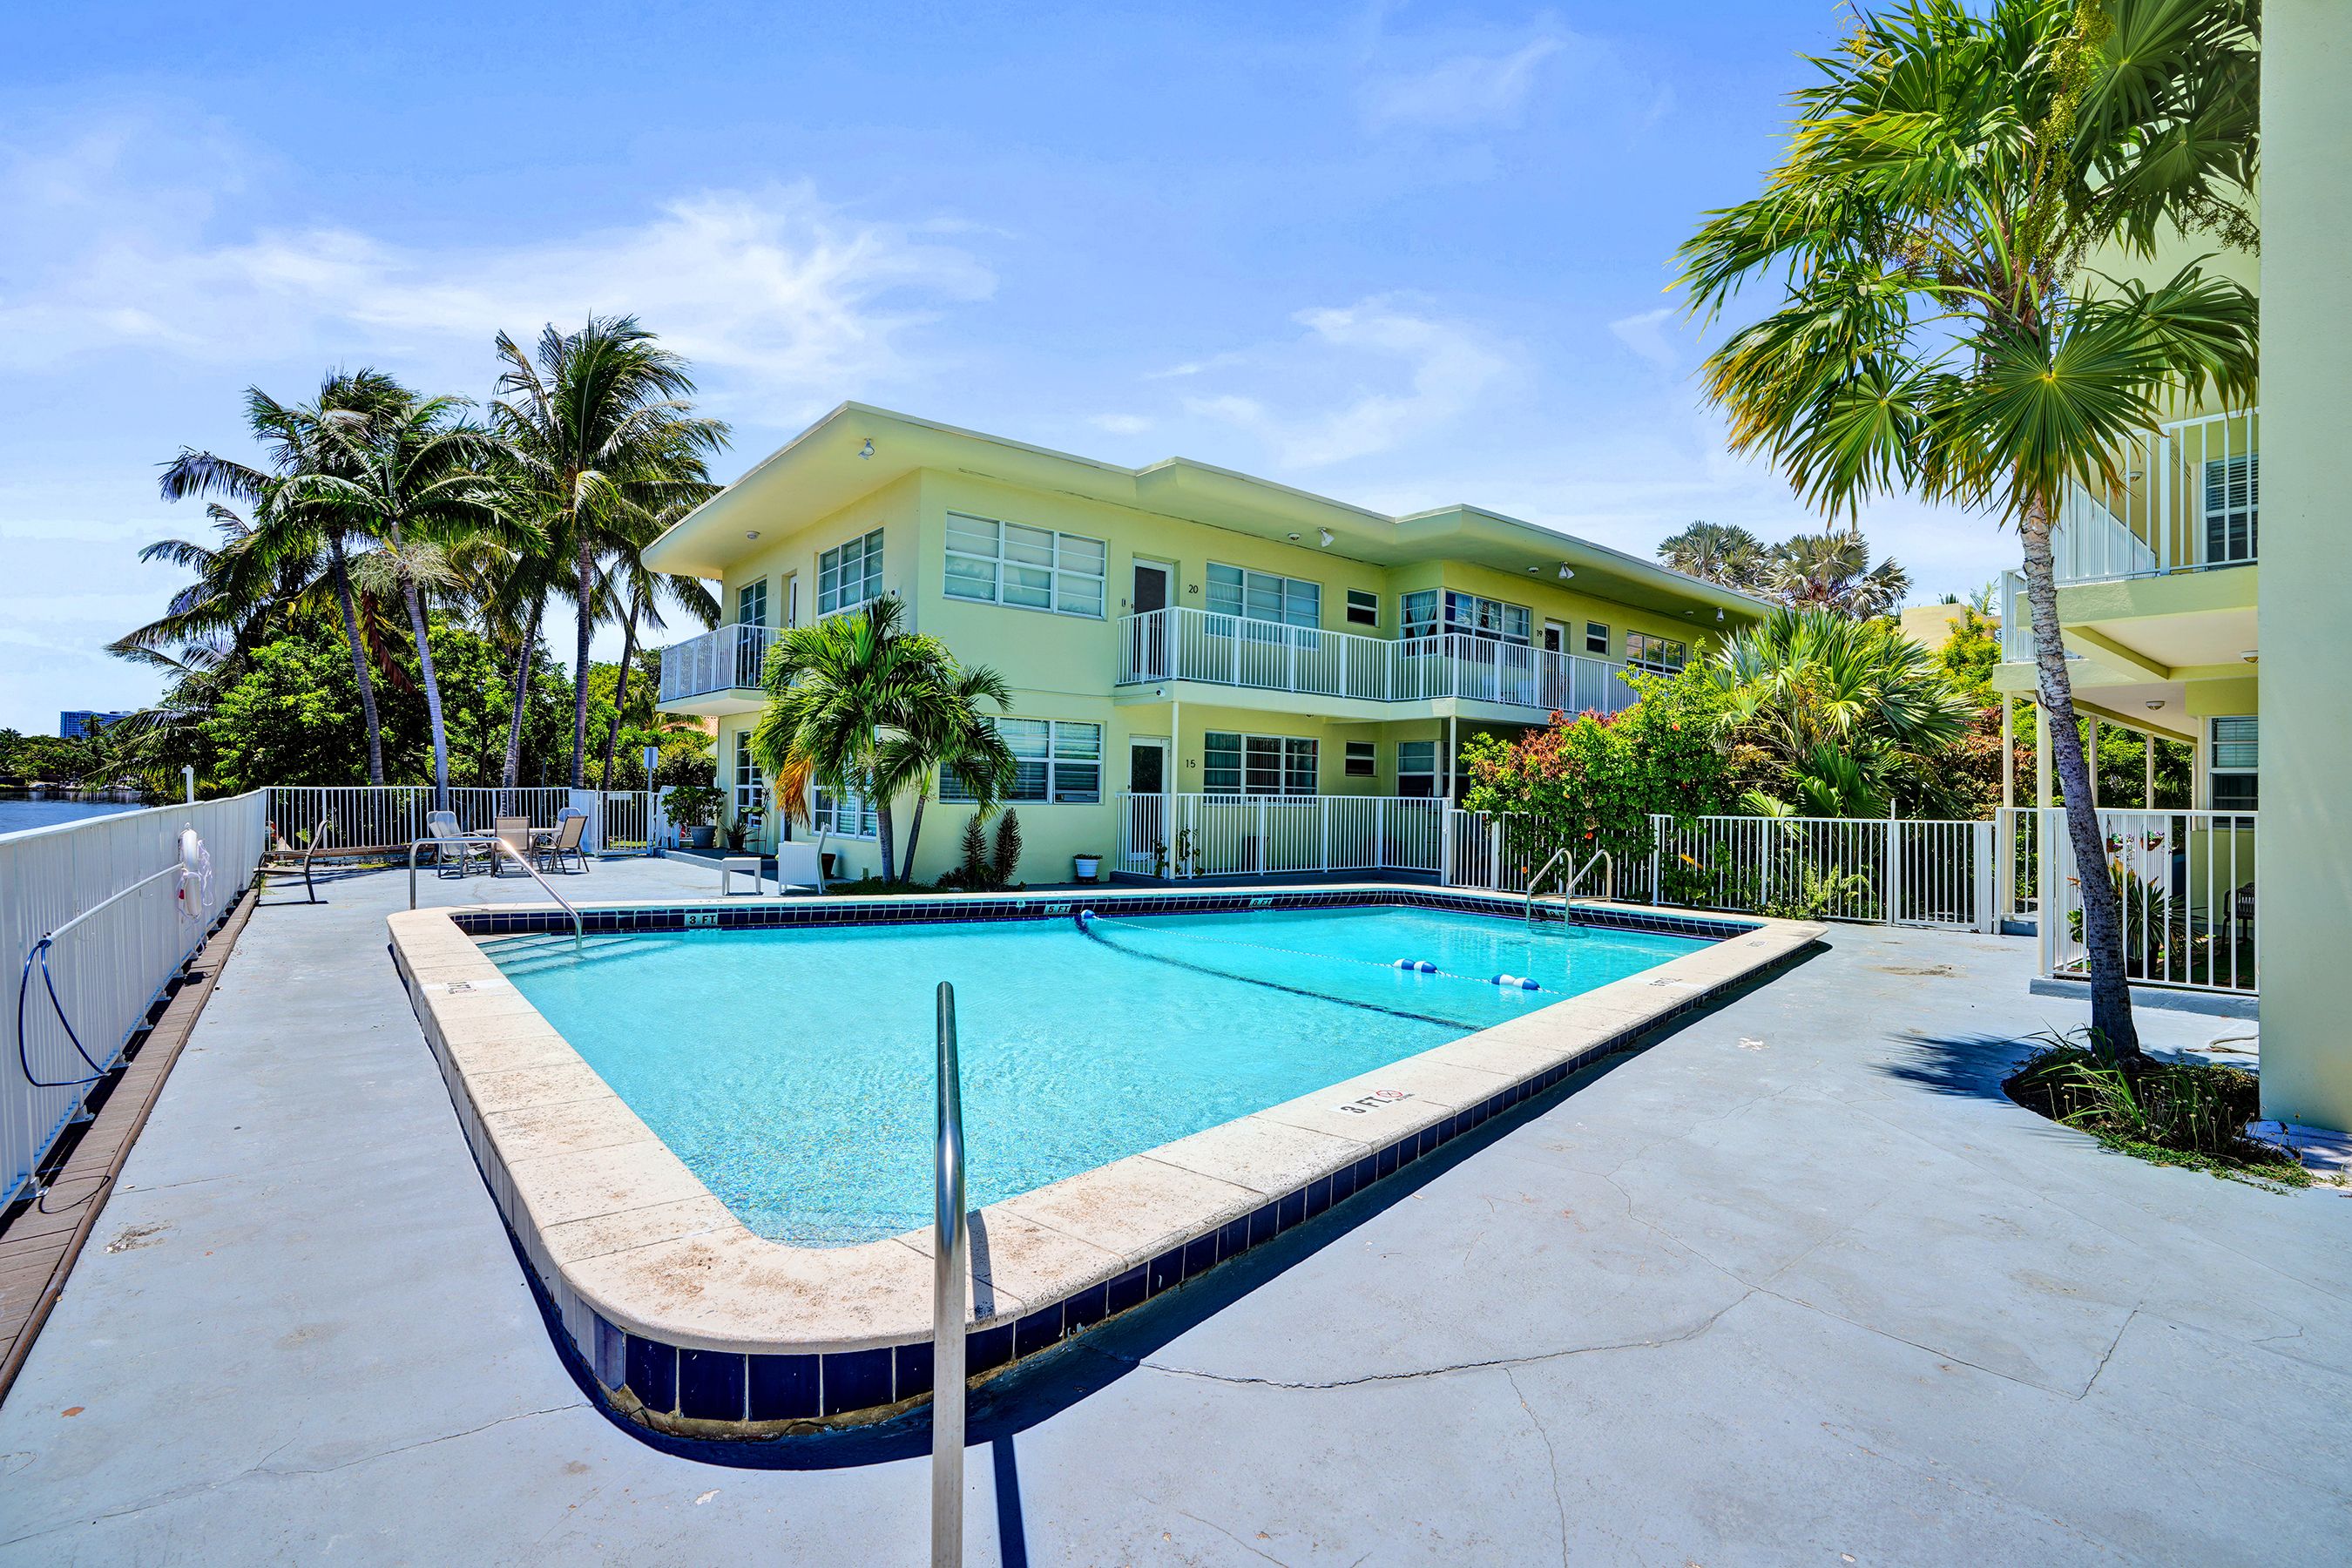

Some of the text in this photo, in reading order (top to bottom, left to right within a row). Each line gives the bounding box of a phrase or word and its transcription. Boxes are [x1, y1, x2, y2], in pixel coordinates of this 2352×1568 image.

[1188, 584, 1199, 594] 20
[1186, 759, 1196, 768] 15
[689, 916, 697, 924] 3
